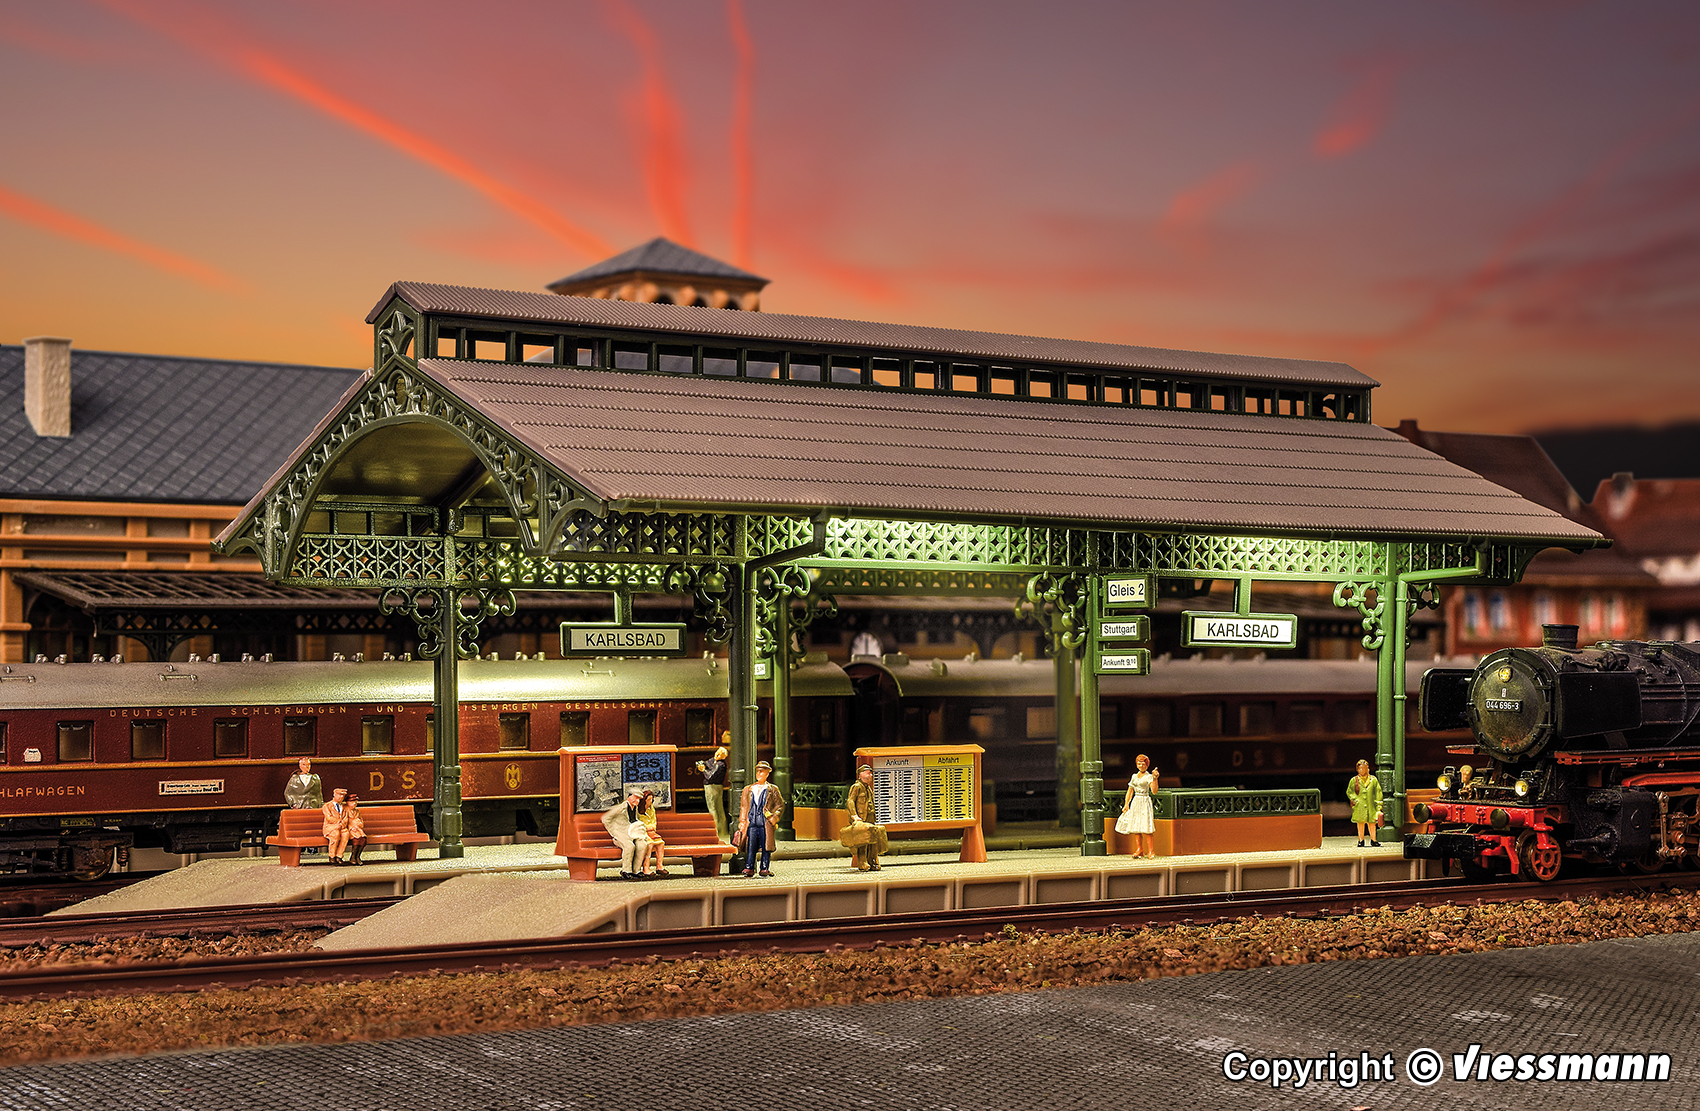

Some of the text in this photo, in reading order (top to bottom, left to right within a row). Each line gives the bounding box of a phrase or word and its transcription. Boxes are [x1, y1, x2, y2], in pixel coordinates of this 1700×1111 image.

[1109, 583, 1144, 597] Gleis 2
[1103, 624, 1136, 635] Stuttgart
[1207, 622, 1279, 639] KARLSBAD
[585, 632, 666, 647] KARLSBAD
[1102, 658, 1125, 666] Ankunft
[109, 708, 199, 718] DEUTSCHE
[230, 706, 347, 716] SCHLAFWAGEN
[376, 704, 405, 713] UND
[564, 701, 674, 710] GESELLSCHAFT
[1486, 700, 1520, 710] 044 696-3
[624, 754, 661, 768] das
[885, 758, 910, 766] Ankunft
[937, 756, 961, 764] Abfahrt
[625, 767, 664, 782] Bad
